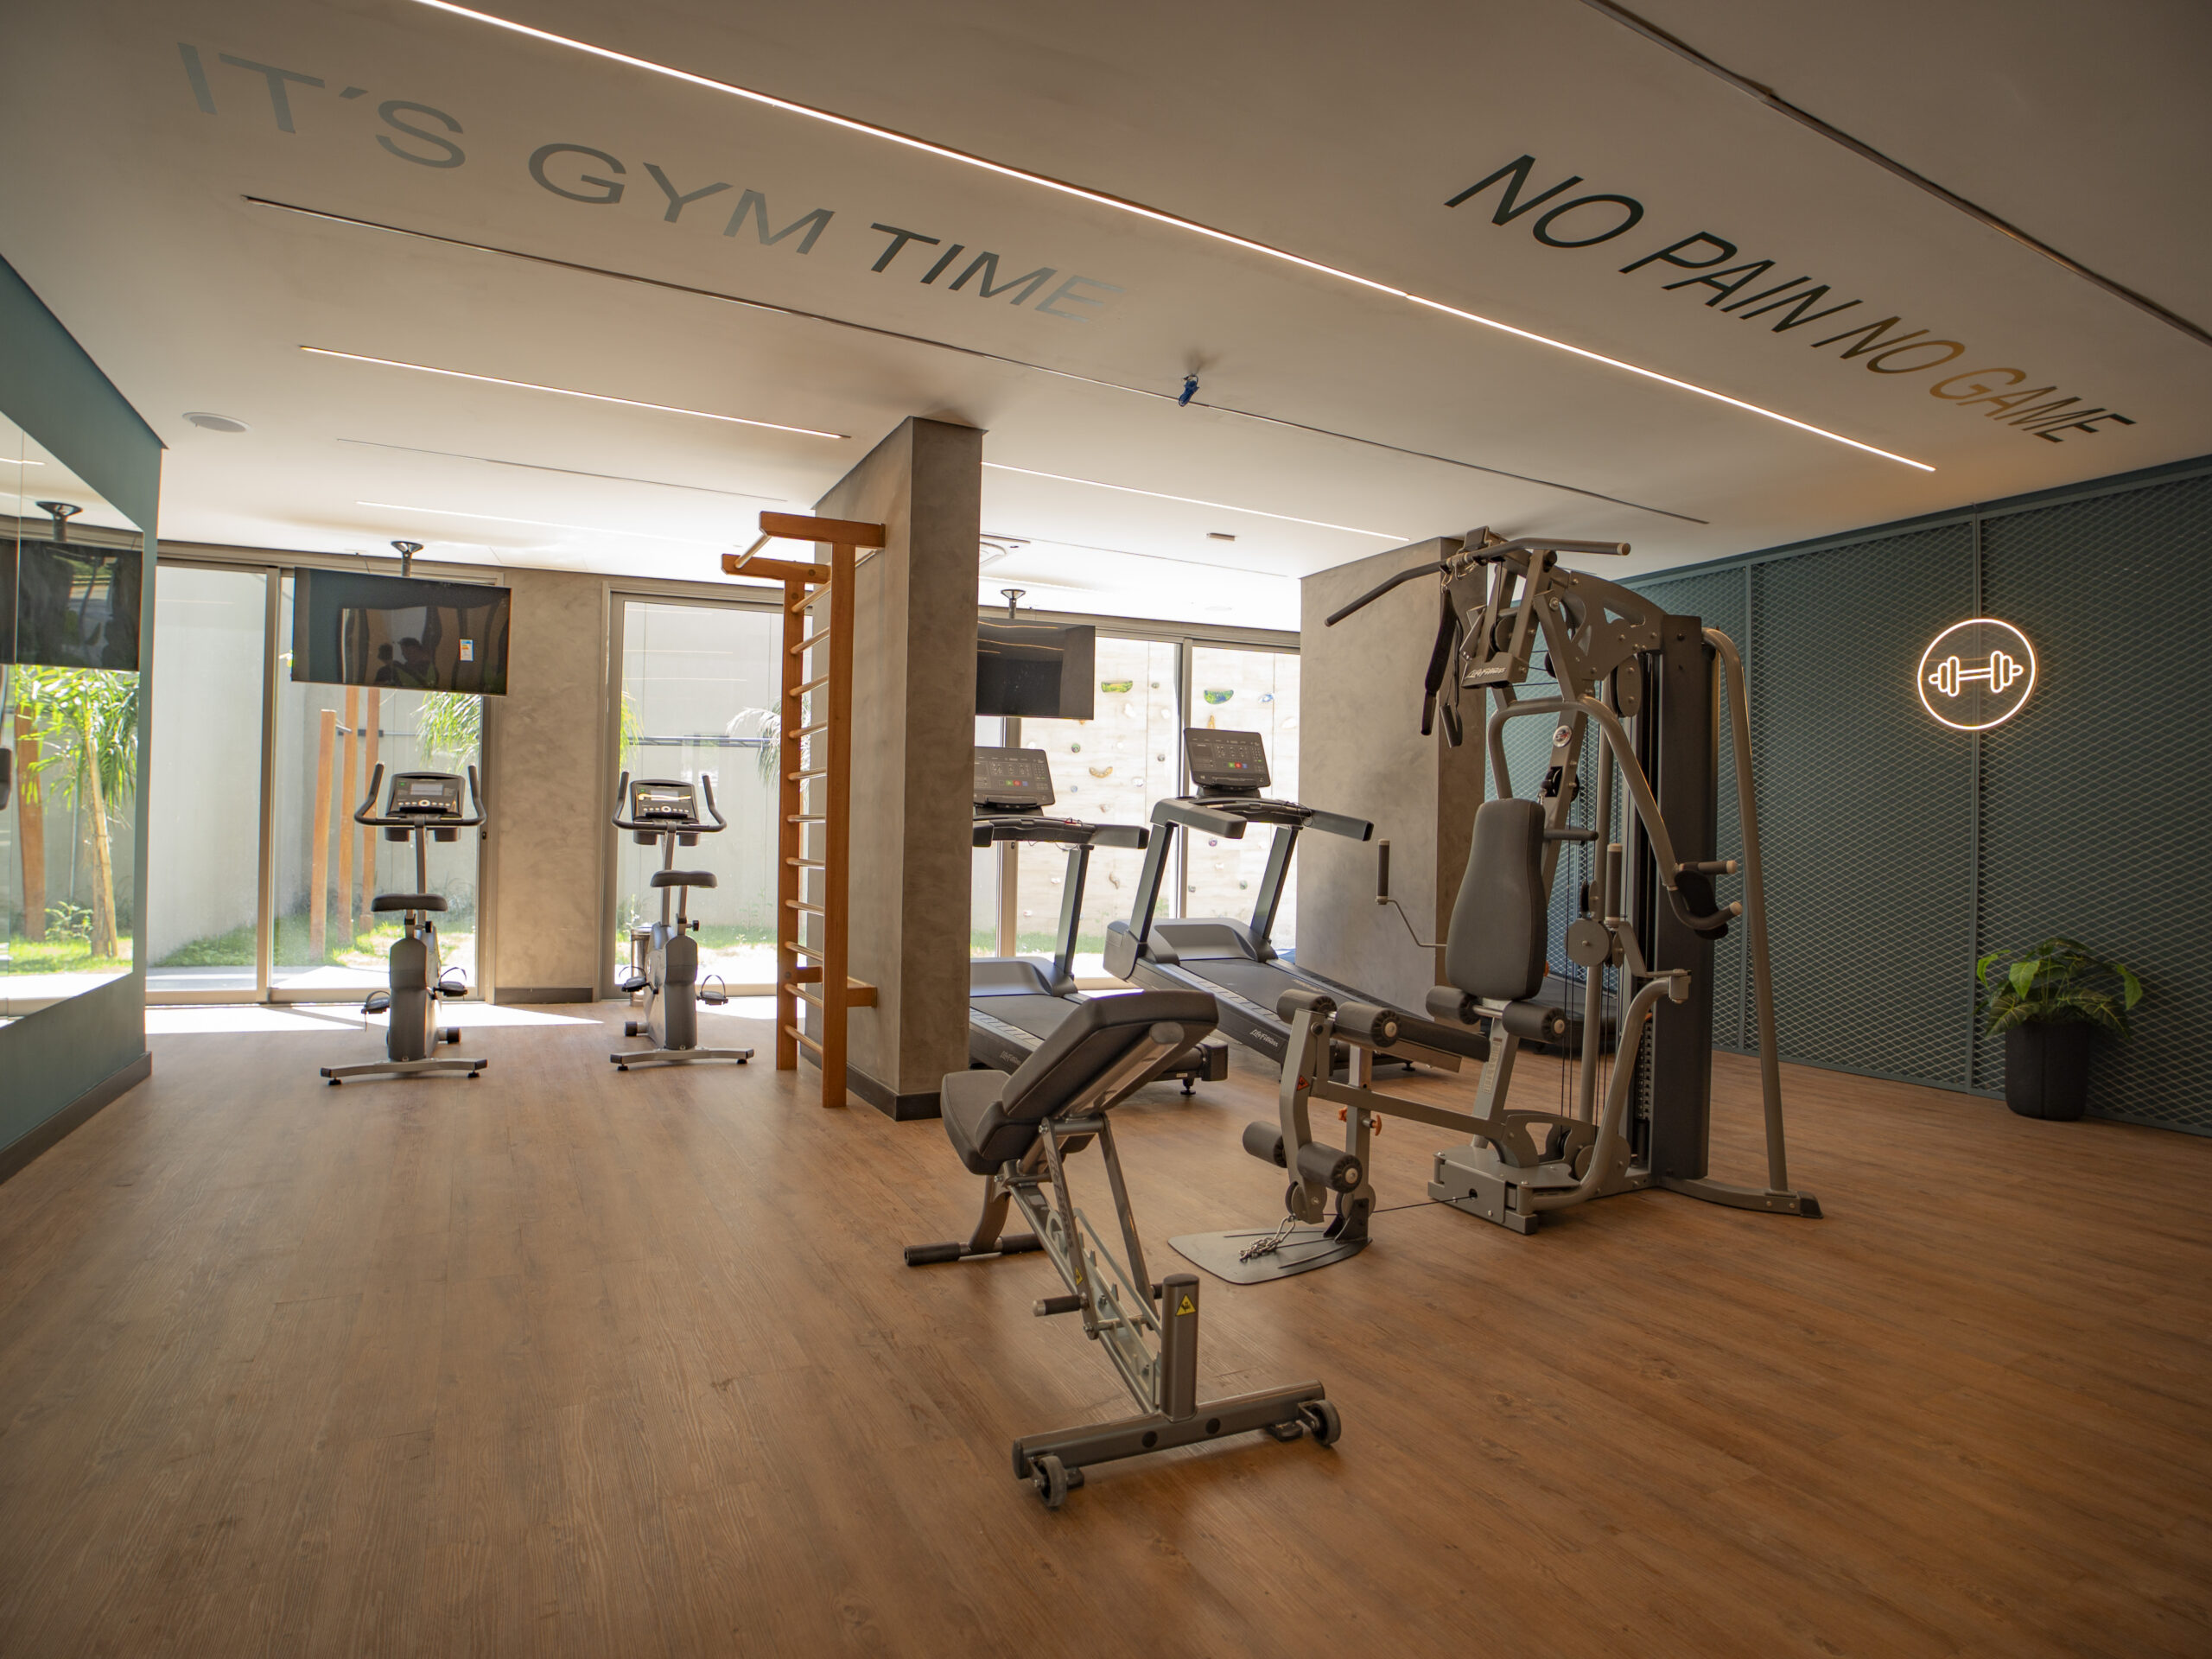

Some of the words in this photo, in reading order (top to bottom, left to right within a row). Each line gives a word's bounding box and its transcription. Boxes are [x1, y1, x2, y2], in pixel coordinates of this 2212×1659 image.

[528, 142, 836, 256] GYM
[869, 221, 1128, 324] TIME
[1442, 154, 1645, 249] NO
[1617, 230, 1864, 334] PAIN
[1810, 315, 1967, 375] NO
[1929, 366, 2138, 444] GAME
